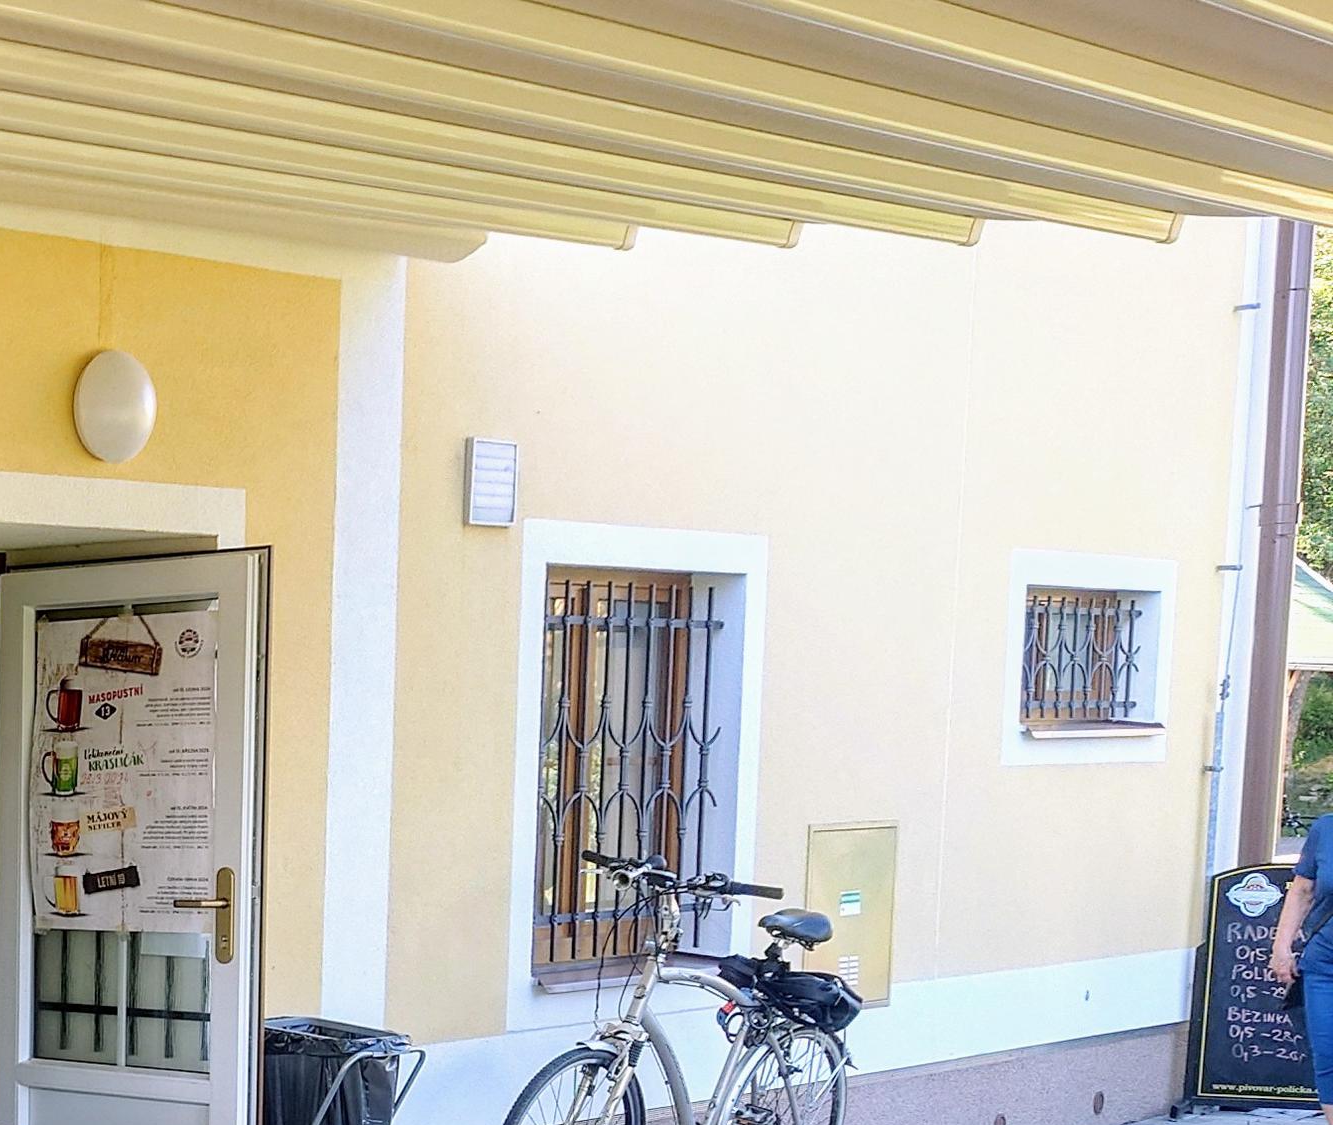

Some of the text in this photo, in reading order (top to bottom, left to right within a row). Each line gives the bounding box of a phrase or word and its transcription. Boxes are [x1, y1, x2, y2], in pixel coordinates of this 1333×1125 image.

[88, 684, 144, 704] MASOPUSTNÍ
[101, 705, 111, 717] 13
[86, 806, 129, 825] MÁJOVÝ
[1226, 1006, 1293, 1028] BEZINKA
